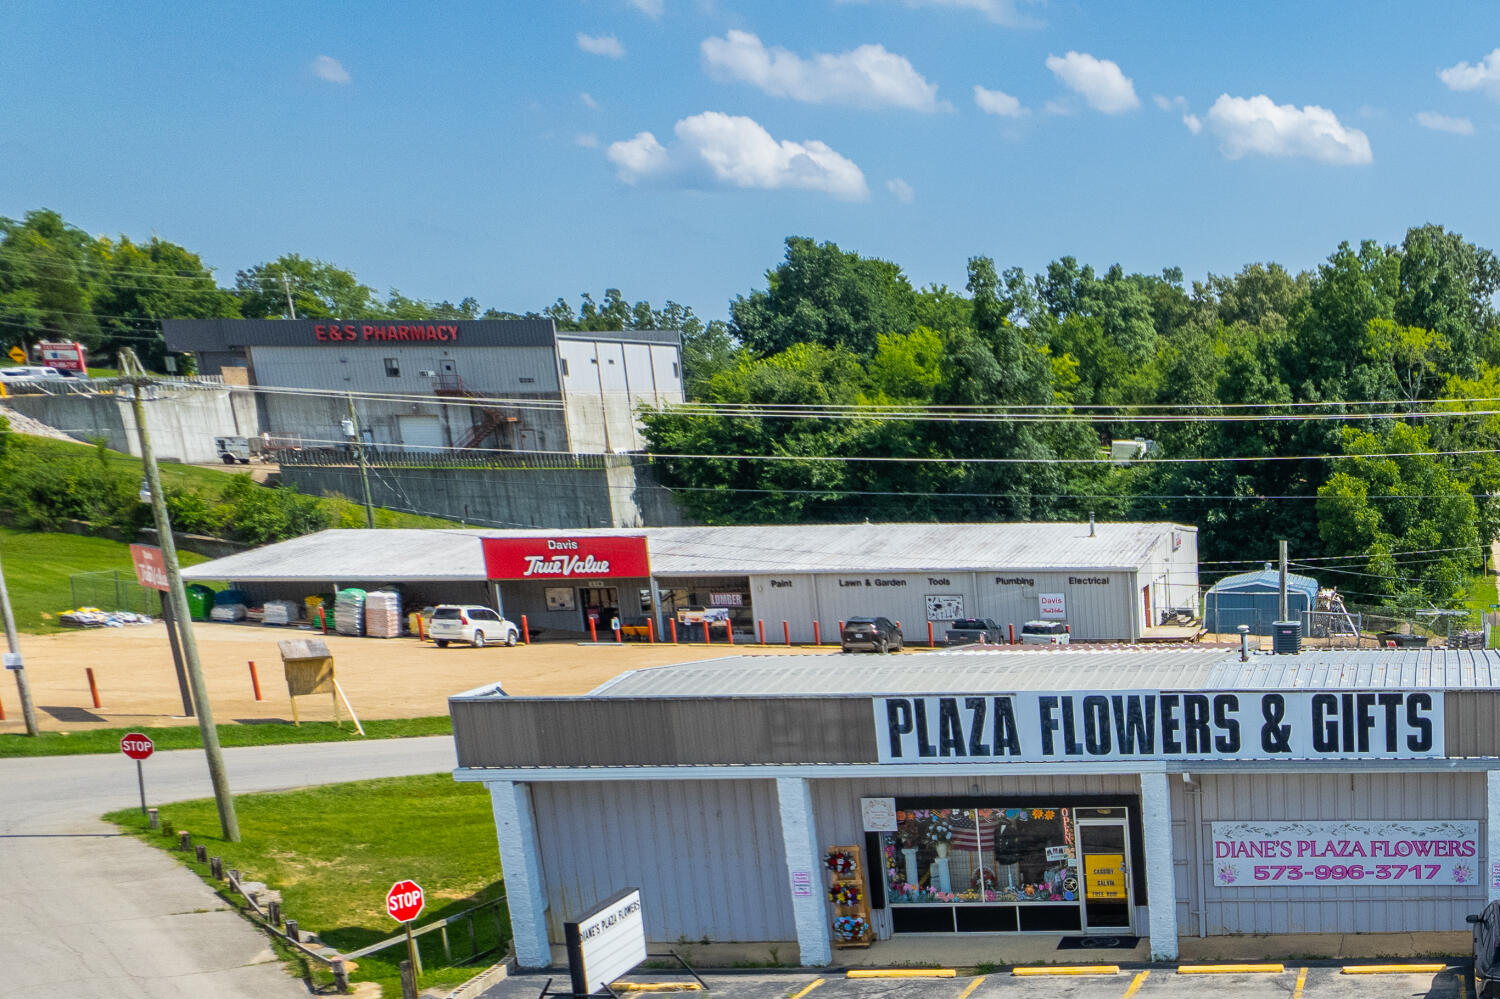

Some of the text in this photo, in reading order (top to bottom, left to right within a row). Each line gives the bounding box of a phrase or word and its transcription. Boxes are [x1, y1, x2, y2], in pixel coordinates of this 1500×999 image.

[315, 325, 458, 341] E&S PHARMACY
[547, 540, 578, 549] Davis
[771, 579, 792, 588] Paint
[839, 578, 907, 587] Lawn & Garden
[928, 578, 951, 586] Tools
[996, 577, 1035, 587] Plumbing
[1069, 577, 1110, 585] Electrical
[886, 693, 1433, 758] PLAZA FLOWERS & GIFTS
[122, 740, 152, 752] STOP
[1061, 808, 1072, 845] OPEN
[1215, 840, 1476, 858] DIANE'S PLAZA FLOWERS
[1254, 864, 1442, 880] 573-996-3717
[389, 890, 421, 911] STOP
